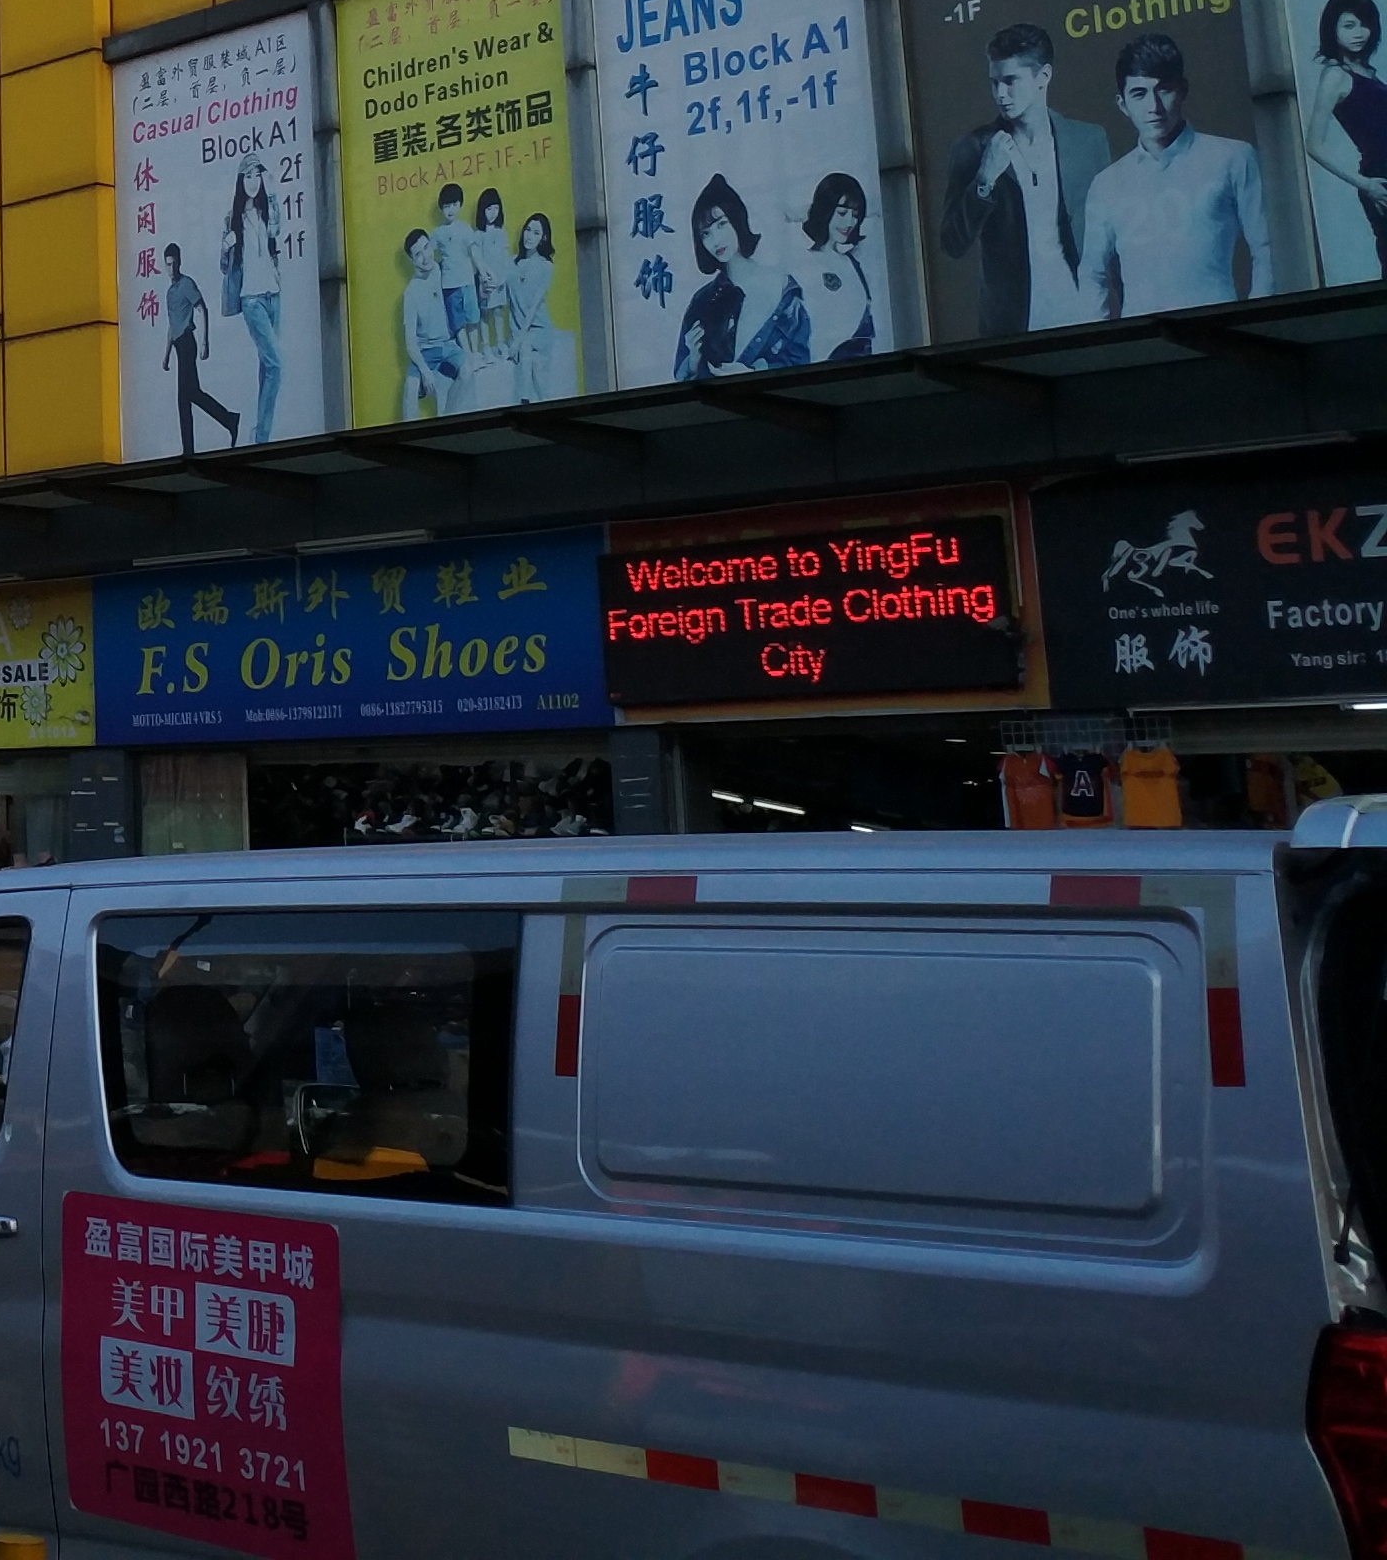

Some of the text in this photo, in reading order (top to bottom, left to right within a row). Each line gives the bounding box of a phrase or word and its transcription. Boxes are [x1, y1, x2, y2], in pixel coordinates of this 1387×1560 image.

[943, 0, 982, 25] -1F
[363, 21, 554, 90] Children's Wear &
[684, 15, 849, 87] Block A1
[132, 83, 299, 145] Casual Clothing
[365, 69, 509, 120] Dodo Fashion
[201, 116, 299, 164] Block A1
[279, 154, 304, 184] 2f
[282, 192, 304, 222] 1f
[378, 166, 429, 196] Block
[434, 159, 456, 183] A1
[624, 64, 675, 309] 牛仔服饰
[133, 156, 162, 328] 休闲服饰
[626, 532, 961, 593] Welcome to YingFu
[606, 583, 996, 644] Foreign Trade Clothing
[1151, 602, 1193, 618] whole
[1195, 599, 1220, 616] life
[1266, 599, 1385, 632] Factory
[135, 622, 548, 695] F.S Oris Shoes
[760, 642, 827, 683] City
[1290, 652, 1334, 670] Yang
[536, 692, 580, 711] A1102
[84, 1216, 315, 1291] 盈富国际美甲城
[110, 1276, 185, 1337] 美甲
[108, 1346, 287, 1432] 美妆 纹绣
[99, 1418, 306, 1492] 137 1921 3721
[104, 1459, 310, 1541] 广园西路218号
